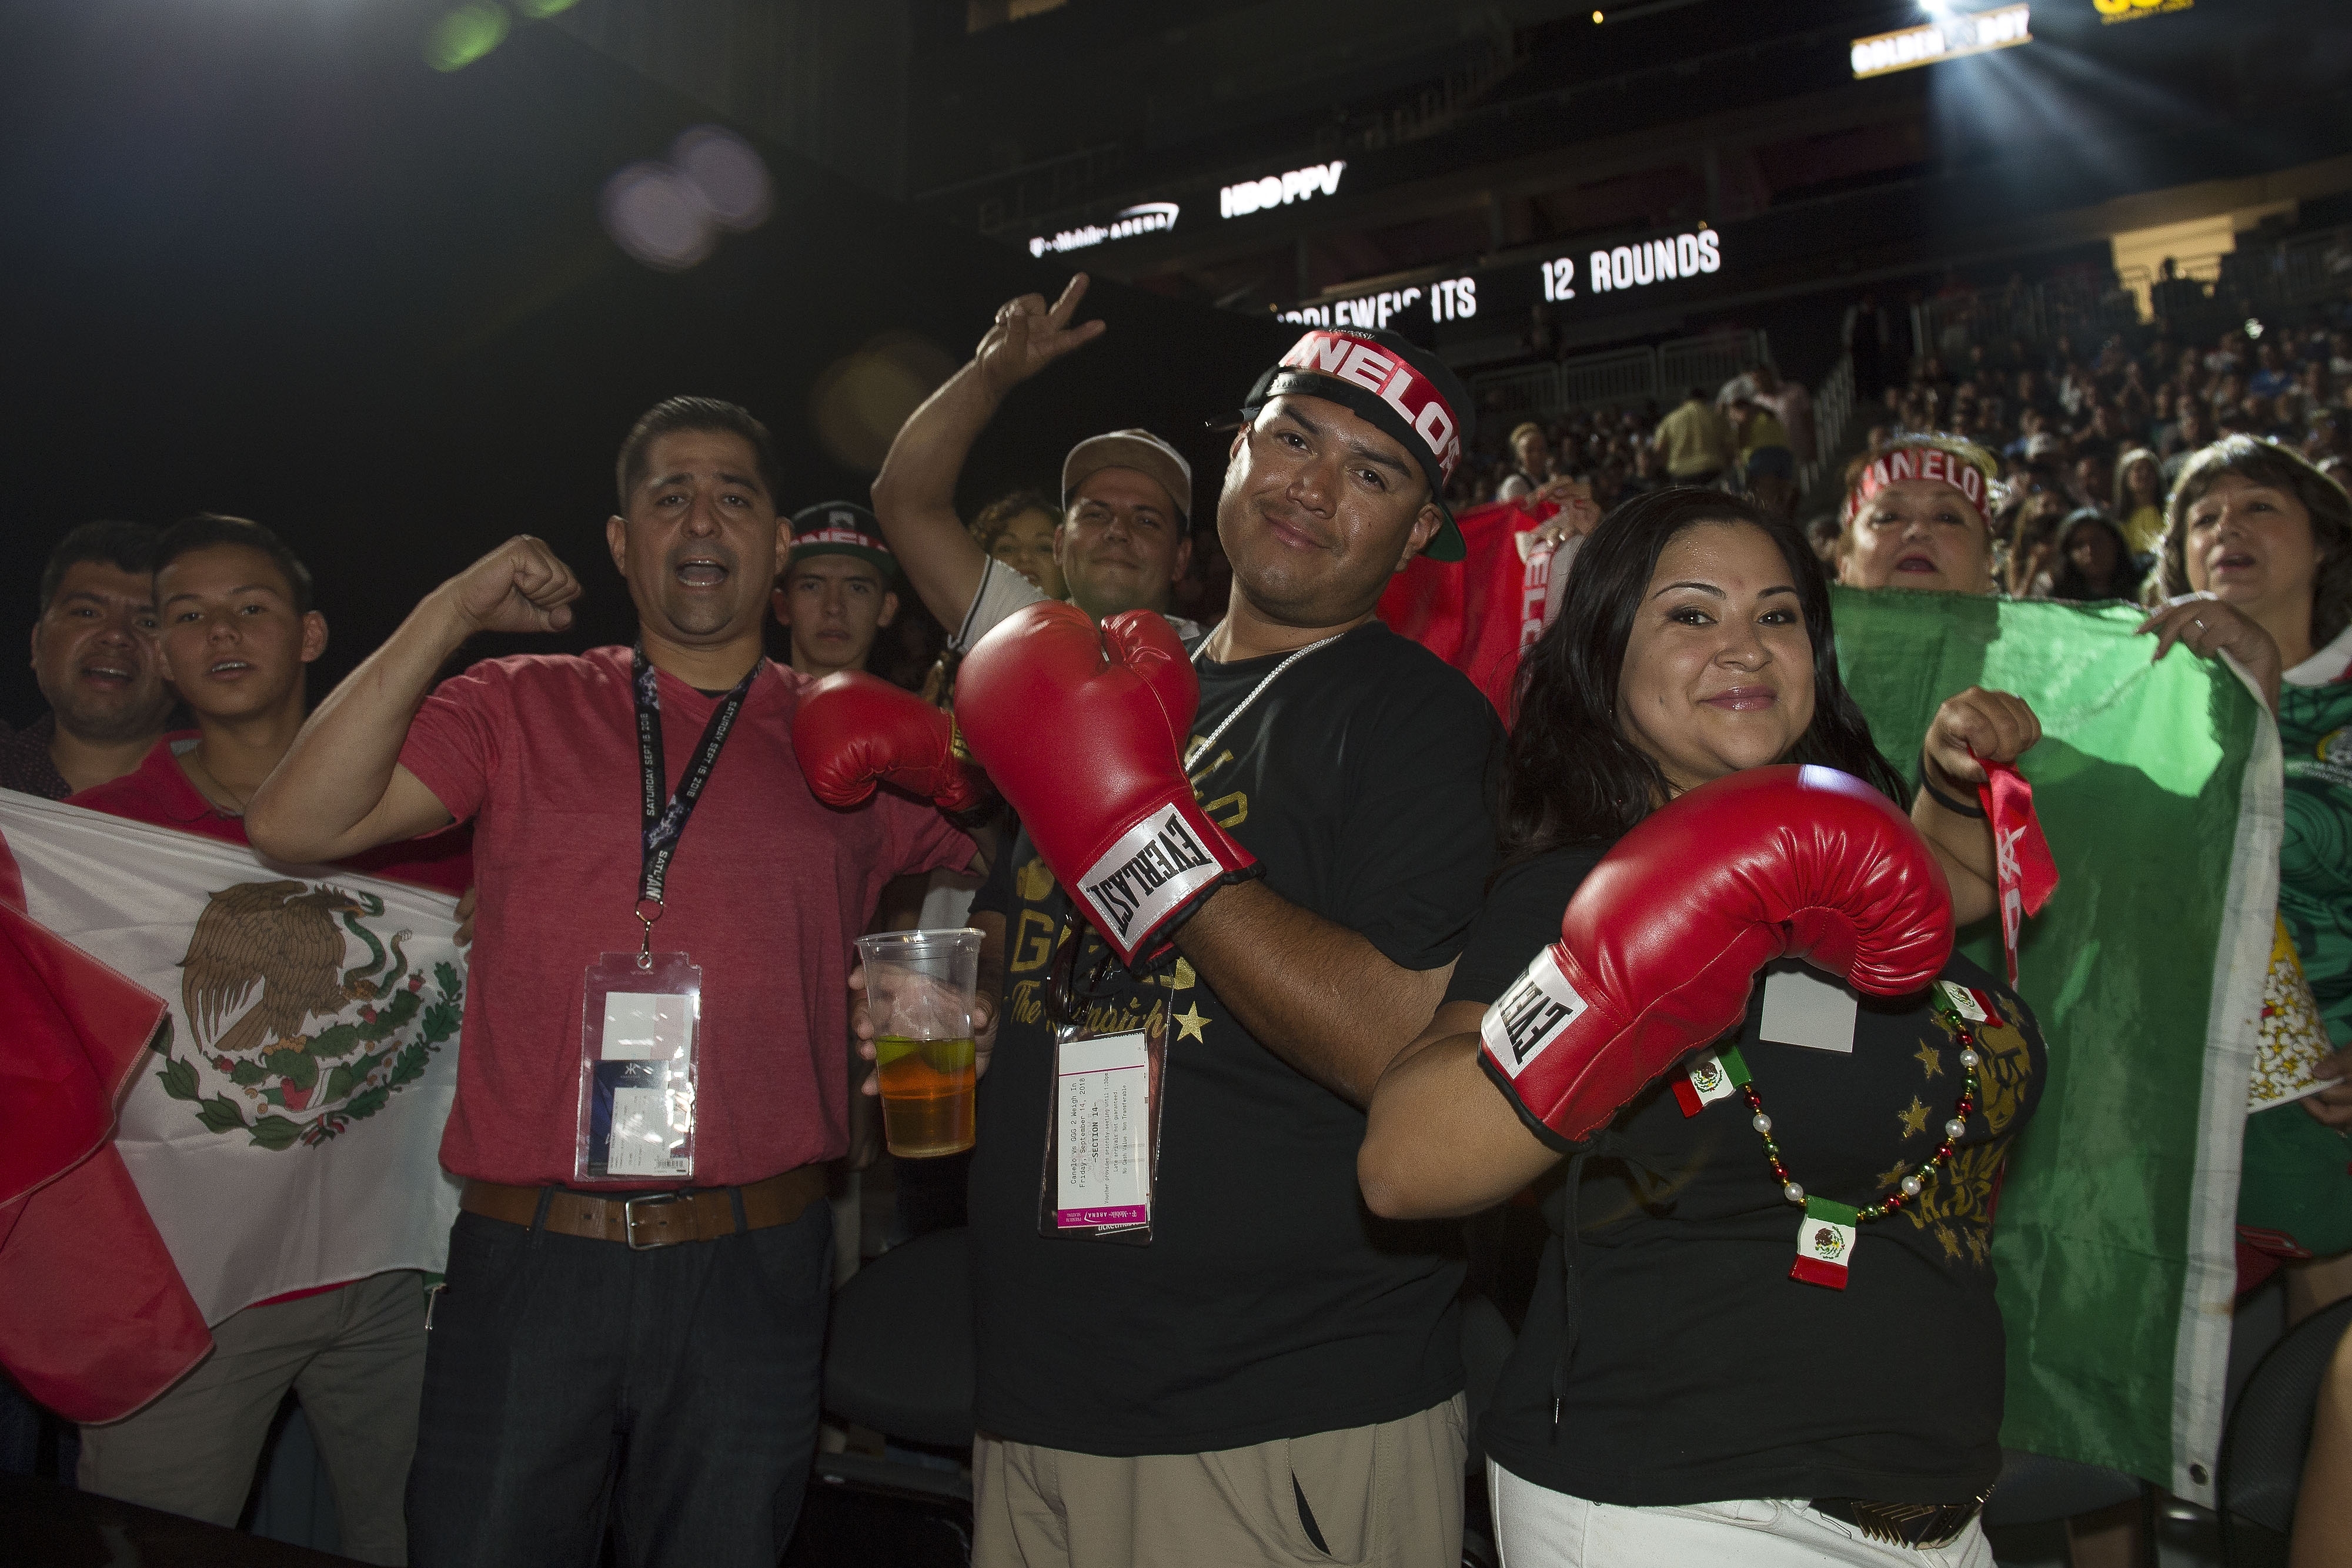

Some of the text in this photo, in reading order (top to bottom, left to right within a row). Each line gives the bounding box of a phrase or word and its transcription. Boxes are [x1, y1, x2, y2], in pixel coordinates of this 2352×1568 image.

[1541, 229, 1720, 302] 12 ROUNDS
[640, 713, 649, 730] 2018
[716, 701, 737, 743] SATURDAY
[644, 744, 653, 765] SEPT
[706, 743, 719, 766] SEPT
[646, 768, 654, 816] SATURDAY
[1087, 813, 1214, 938] EVERLAST
